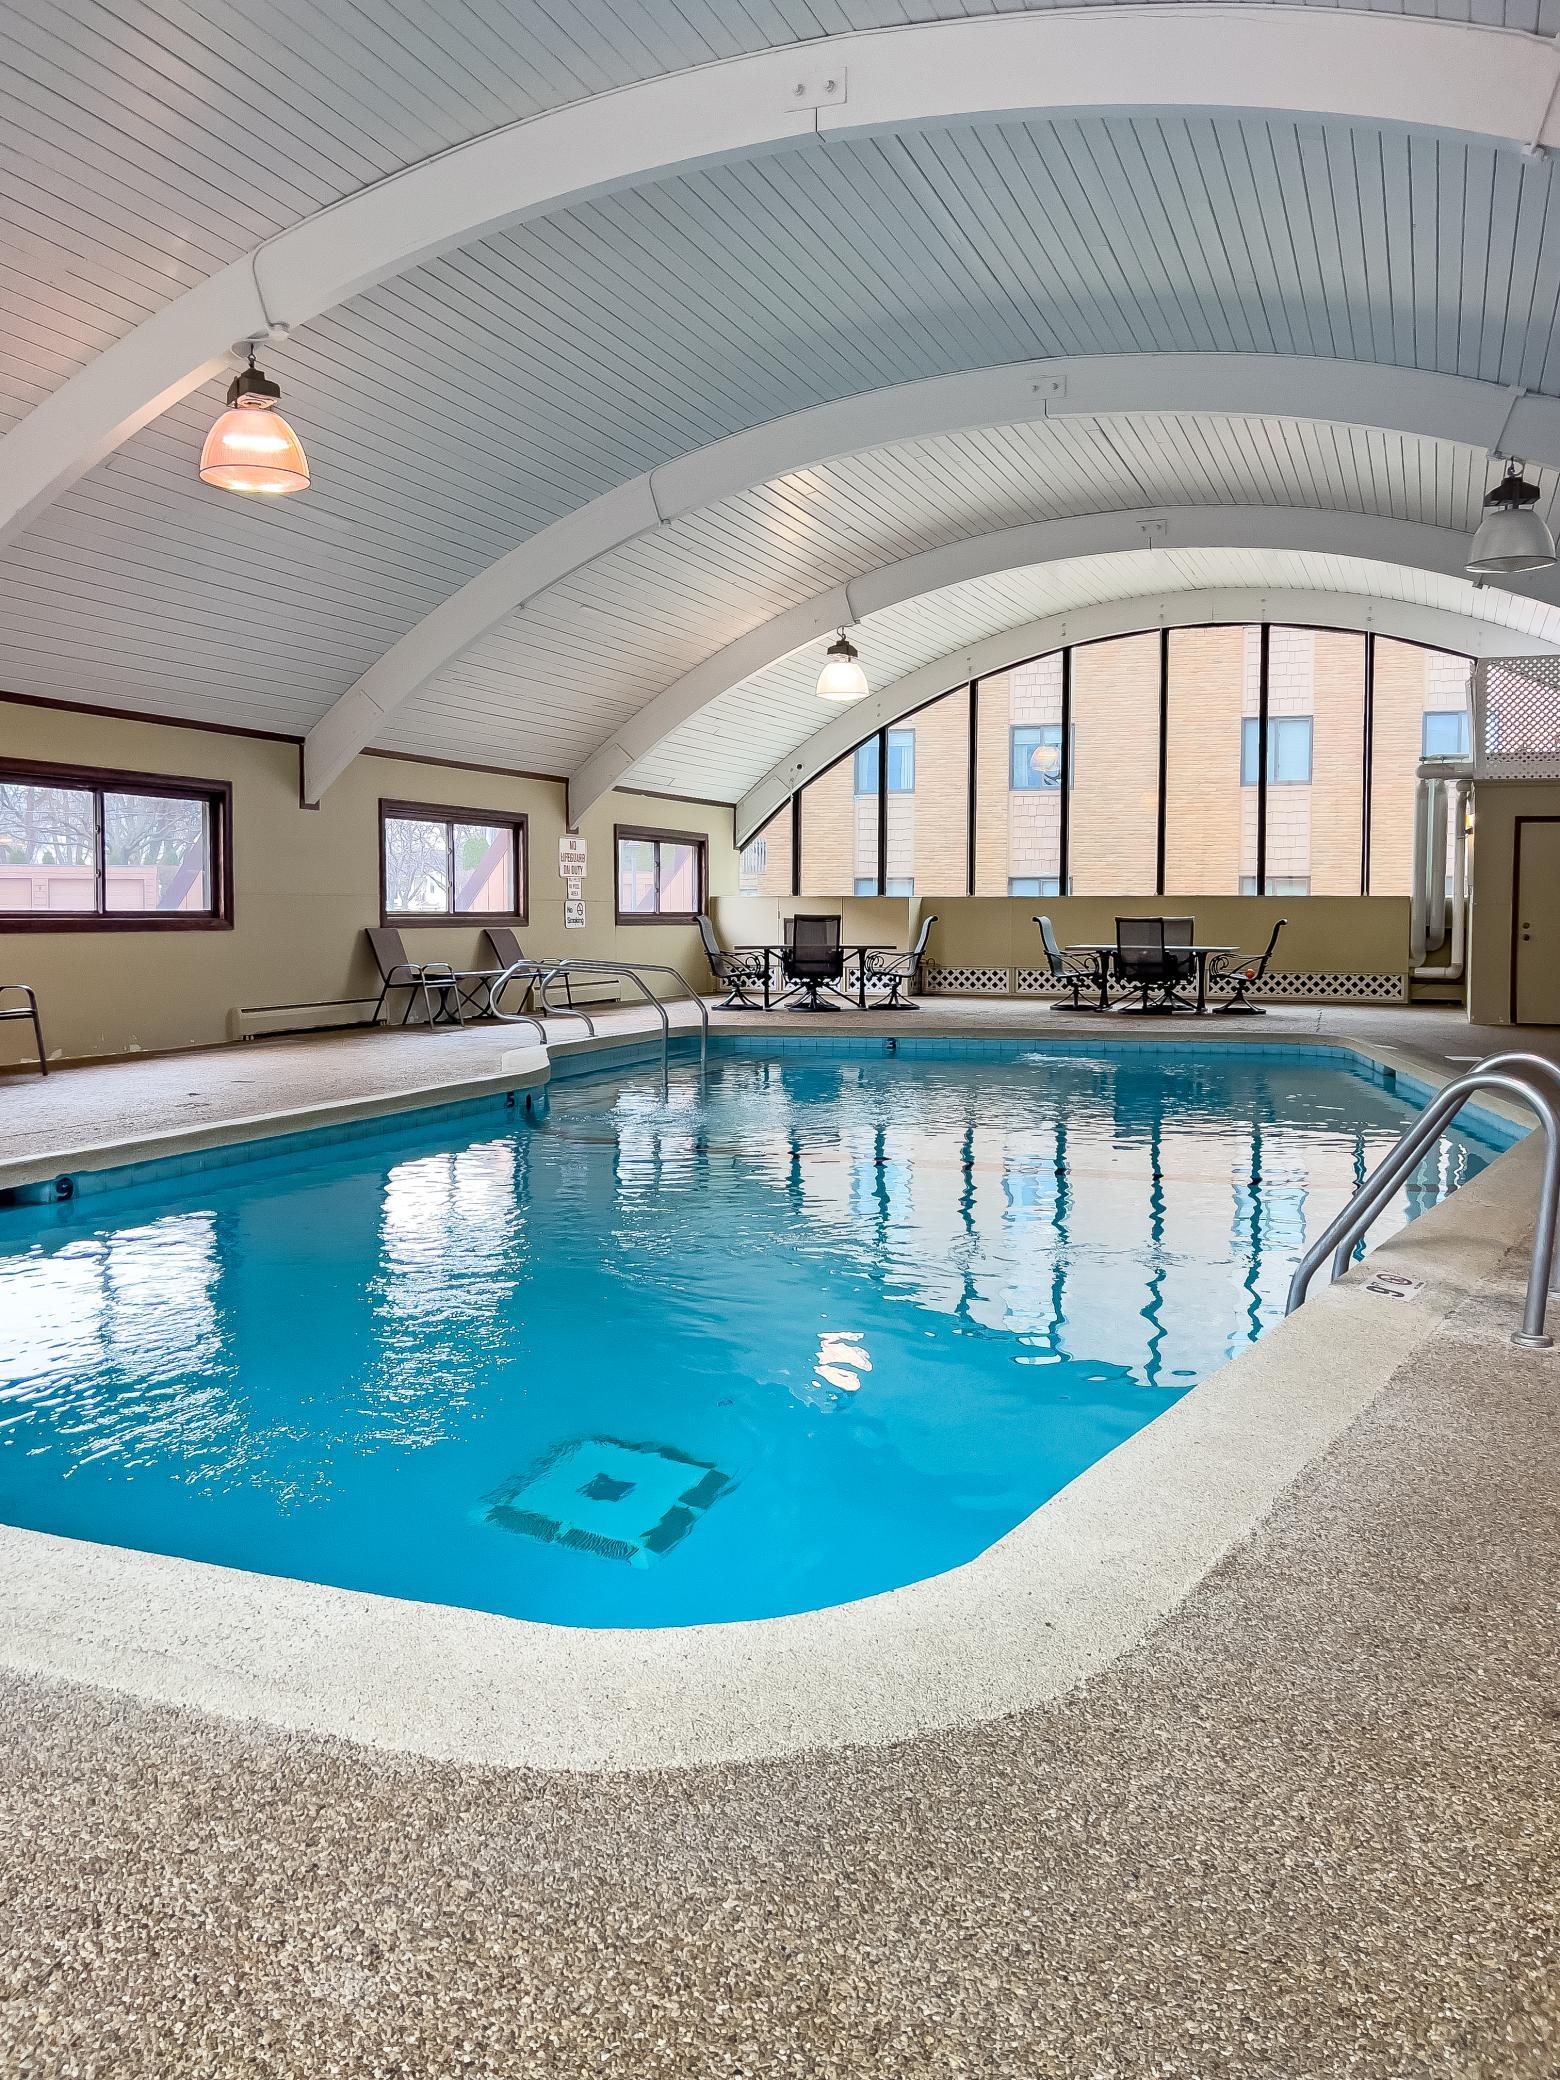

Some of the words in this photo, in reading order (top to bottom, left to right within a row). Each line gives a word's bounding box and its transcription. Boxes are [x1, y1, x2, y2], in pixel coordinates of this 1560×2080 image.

[569, 840, 576, 850] NO
[560, 852, 585, 863] LIFEGUARD
[563, 864, 570, 875] ON
[571, 865, 584, 875] DUTY
[567, 906, 574, 914] No
[567, 916, 585, 926] Smoking
[56, 1177, 74, 1201] 9
